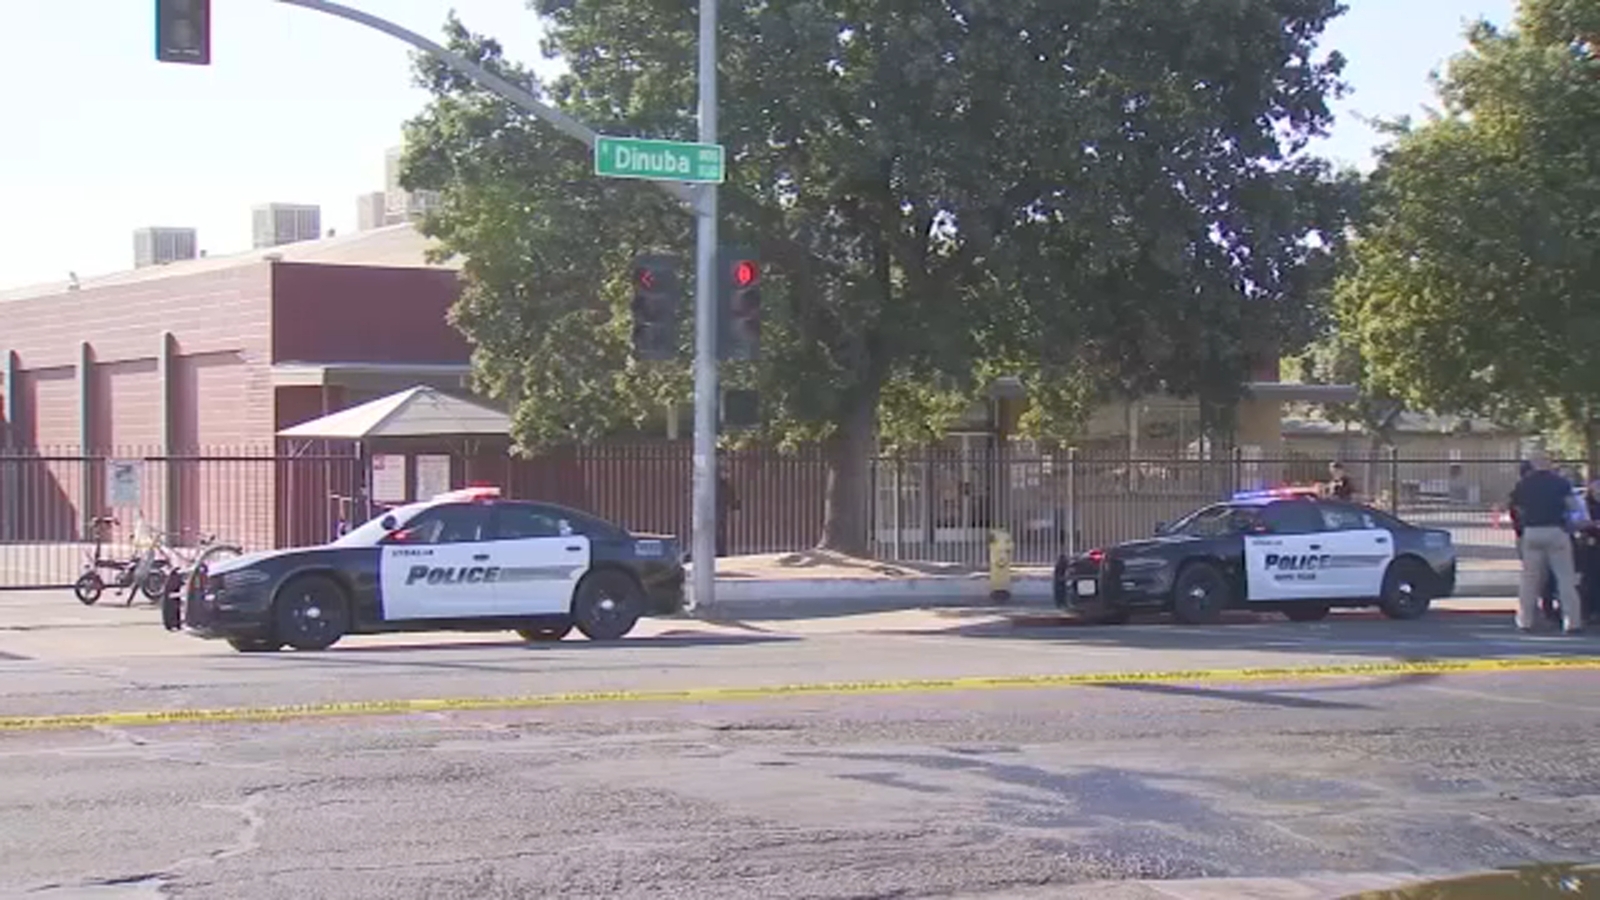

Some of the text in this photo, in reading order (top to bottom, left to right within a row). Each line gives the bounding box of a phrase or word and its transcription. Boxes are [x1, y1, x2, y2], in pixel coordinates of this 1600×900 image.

[615, 145, 690, 173] Dinuba
[1264, 554, 1331, 570] POLICE
[405, 565, 501, 585] POLICE
